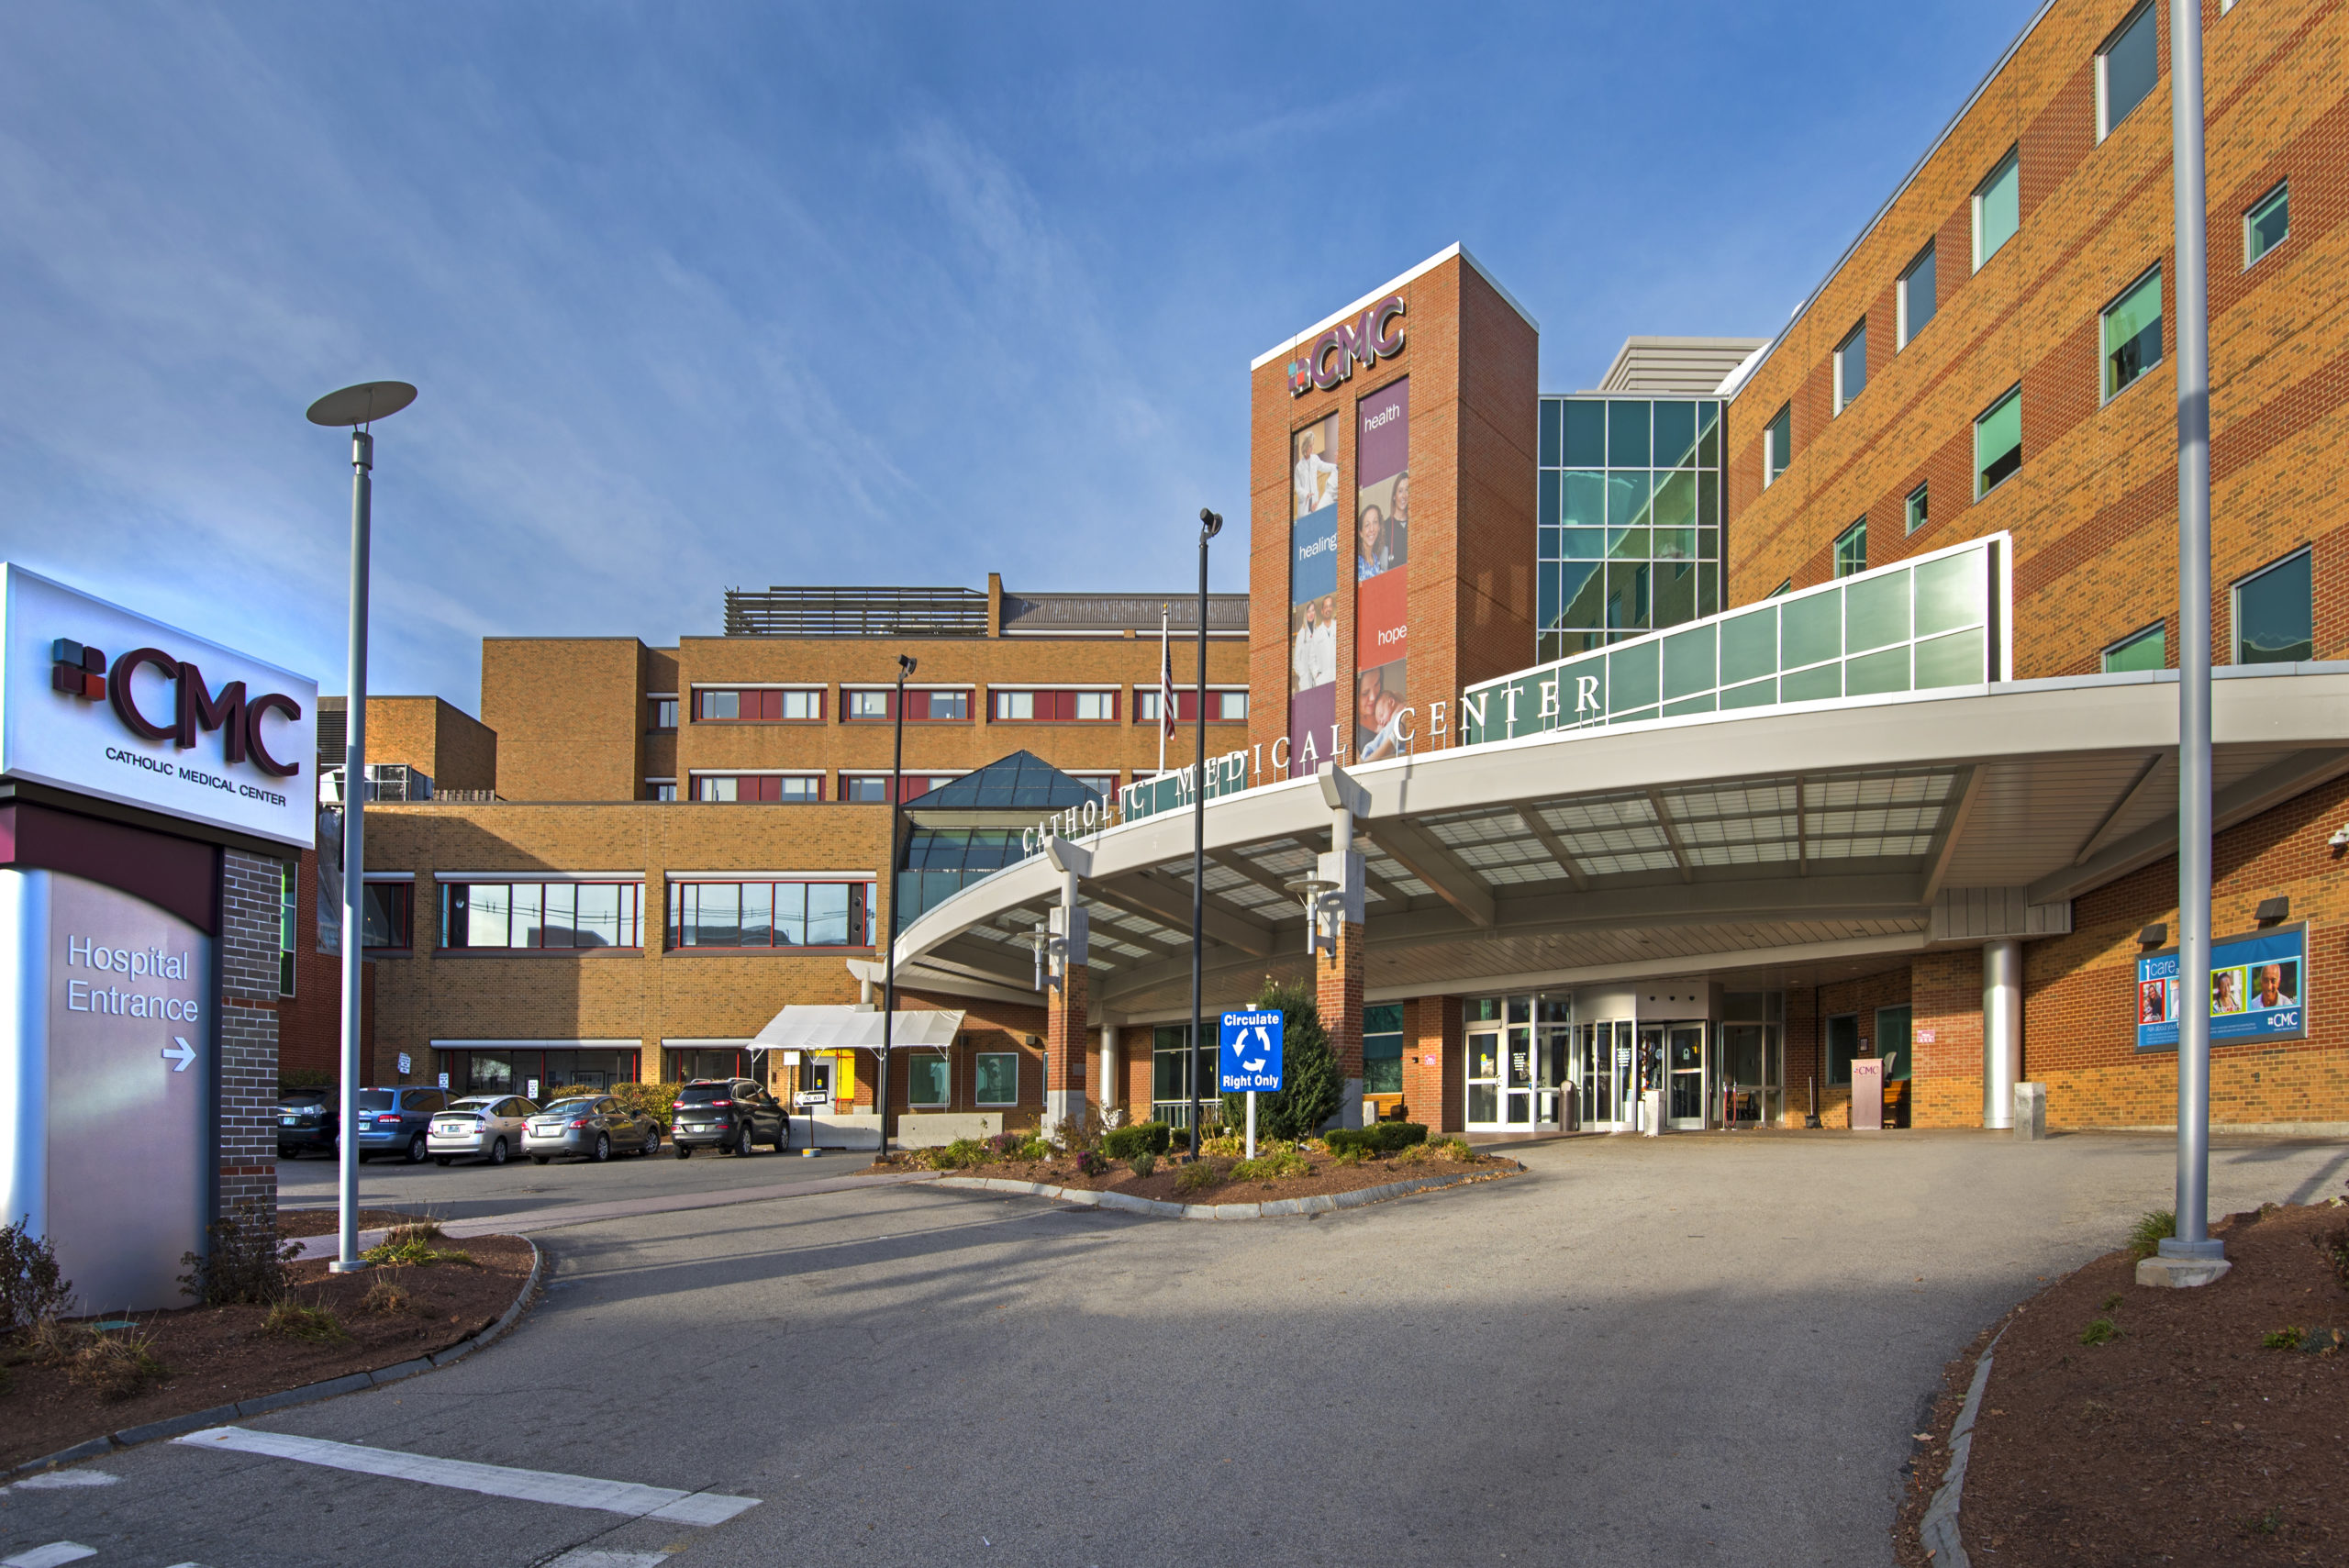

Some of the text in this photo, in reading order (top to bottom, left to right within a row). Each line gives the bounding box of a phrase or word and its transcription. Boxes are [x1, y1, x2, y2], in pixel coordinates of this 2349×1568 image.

[1310, 296, 1404, 389] CMC
[1364, 404, 1400, 433] health
[1299, 532, 1338, 561] healing
[1378, 624, 1408, 646] hope
[108, 647, 301, 777] CMC
[106, 747, 286, 807] CATHOLIC MEDICAL CENTER
[1022, 675, 1601, 852] CATHOLIC MEDICAL CENTER
[68, 934, 189, 981] Hospital
[67, 978, 199, 1023] Entrance
[1224, 1013, 1280, 1026] Circulate
[2274, 1011, 2298, 1028] CMC
[1223, 1074, 1279, 1089] Right Only
[1858, 1065, 1879, 1075] CMC
